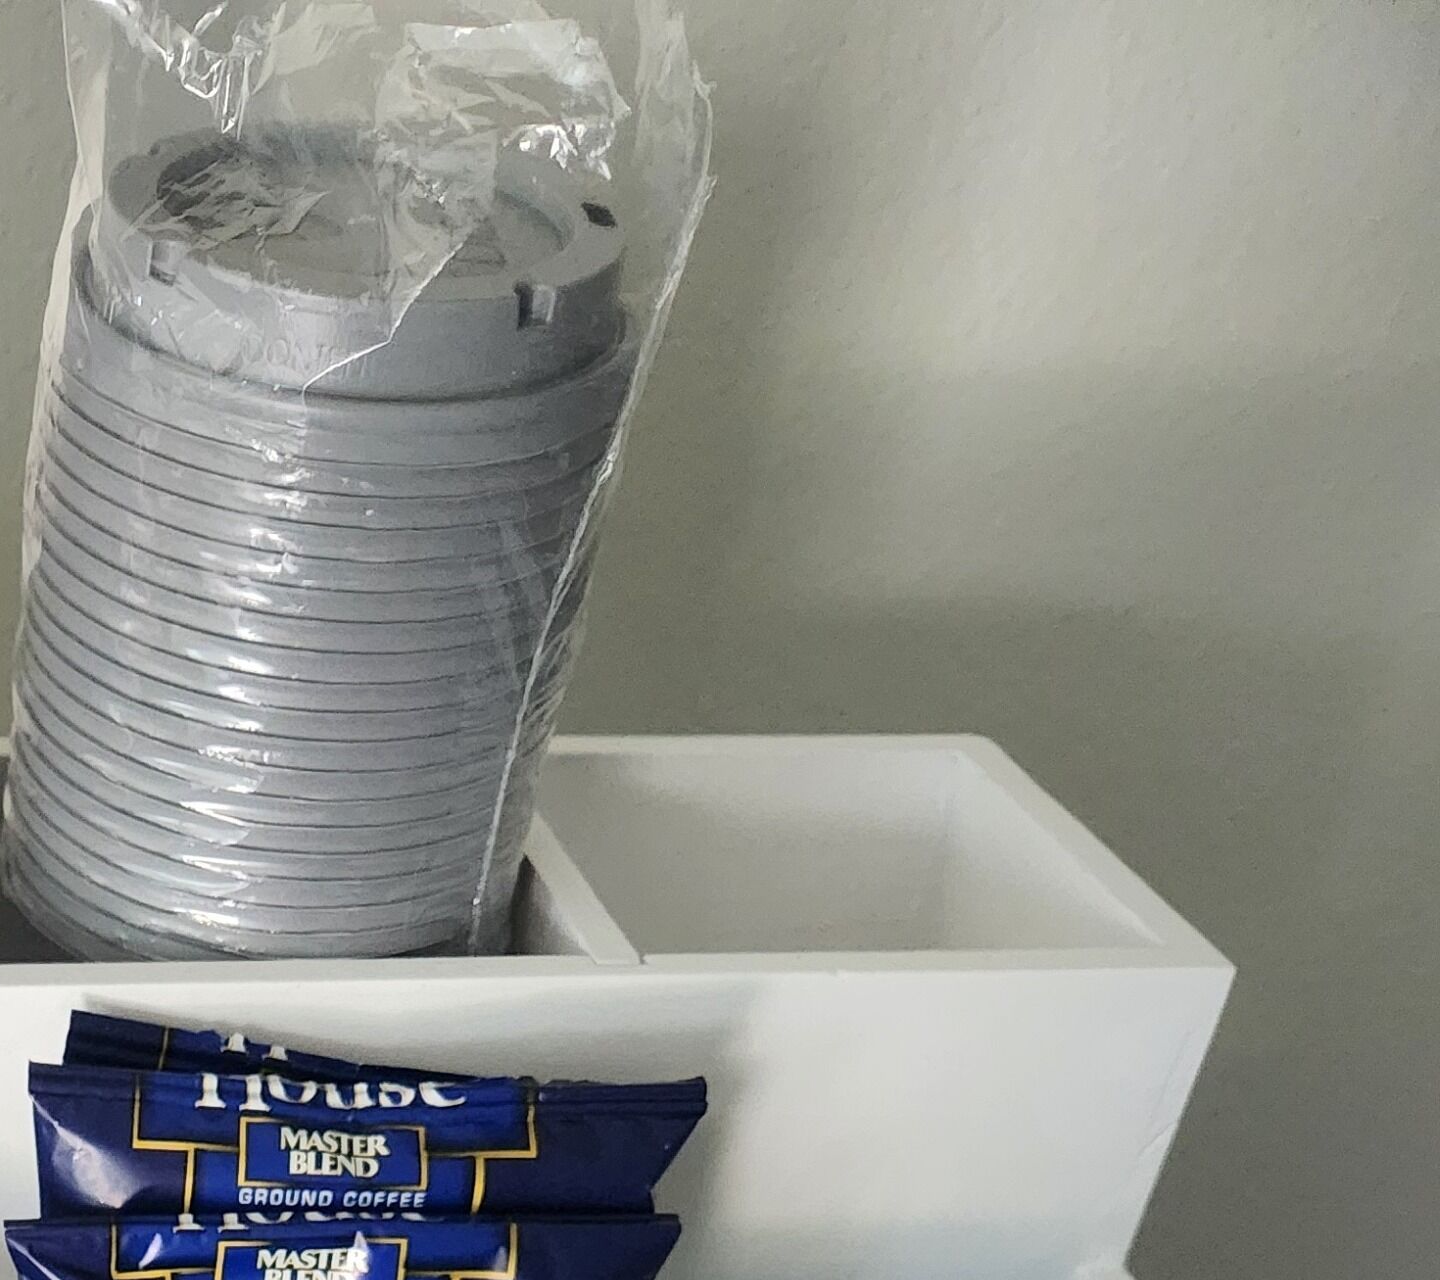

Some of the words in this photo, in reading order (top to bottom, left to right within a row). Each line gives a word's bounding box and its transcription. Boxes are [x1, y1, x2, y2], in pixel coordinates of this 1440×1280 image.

[280, 1126, 391, 1156] MASTER
[288, 1151, 380, 1177] BLEND
[238, 1188, 333, 1207] GROUND
[343, 1190, 428, 1208] COFFEE
[257, 1249, 369, 1273] MASTER
